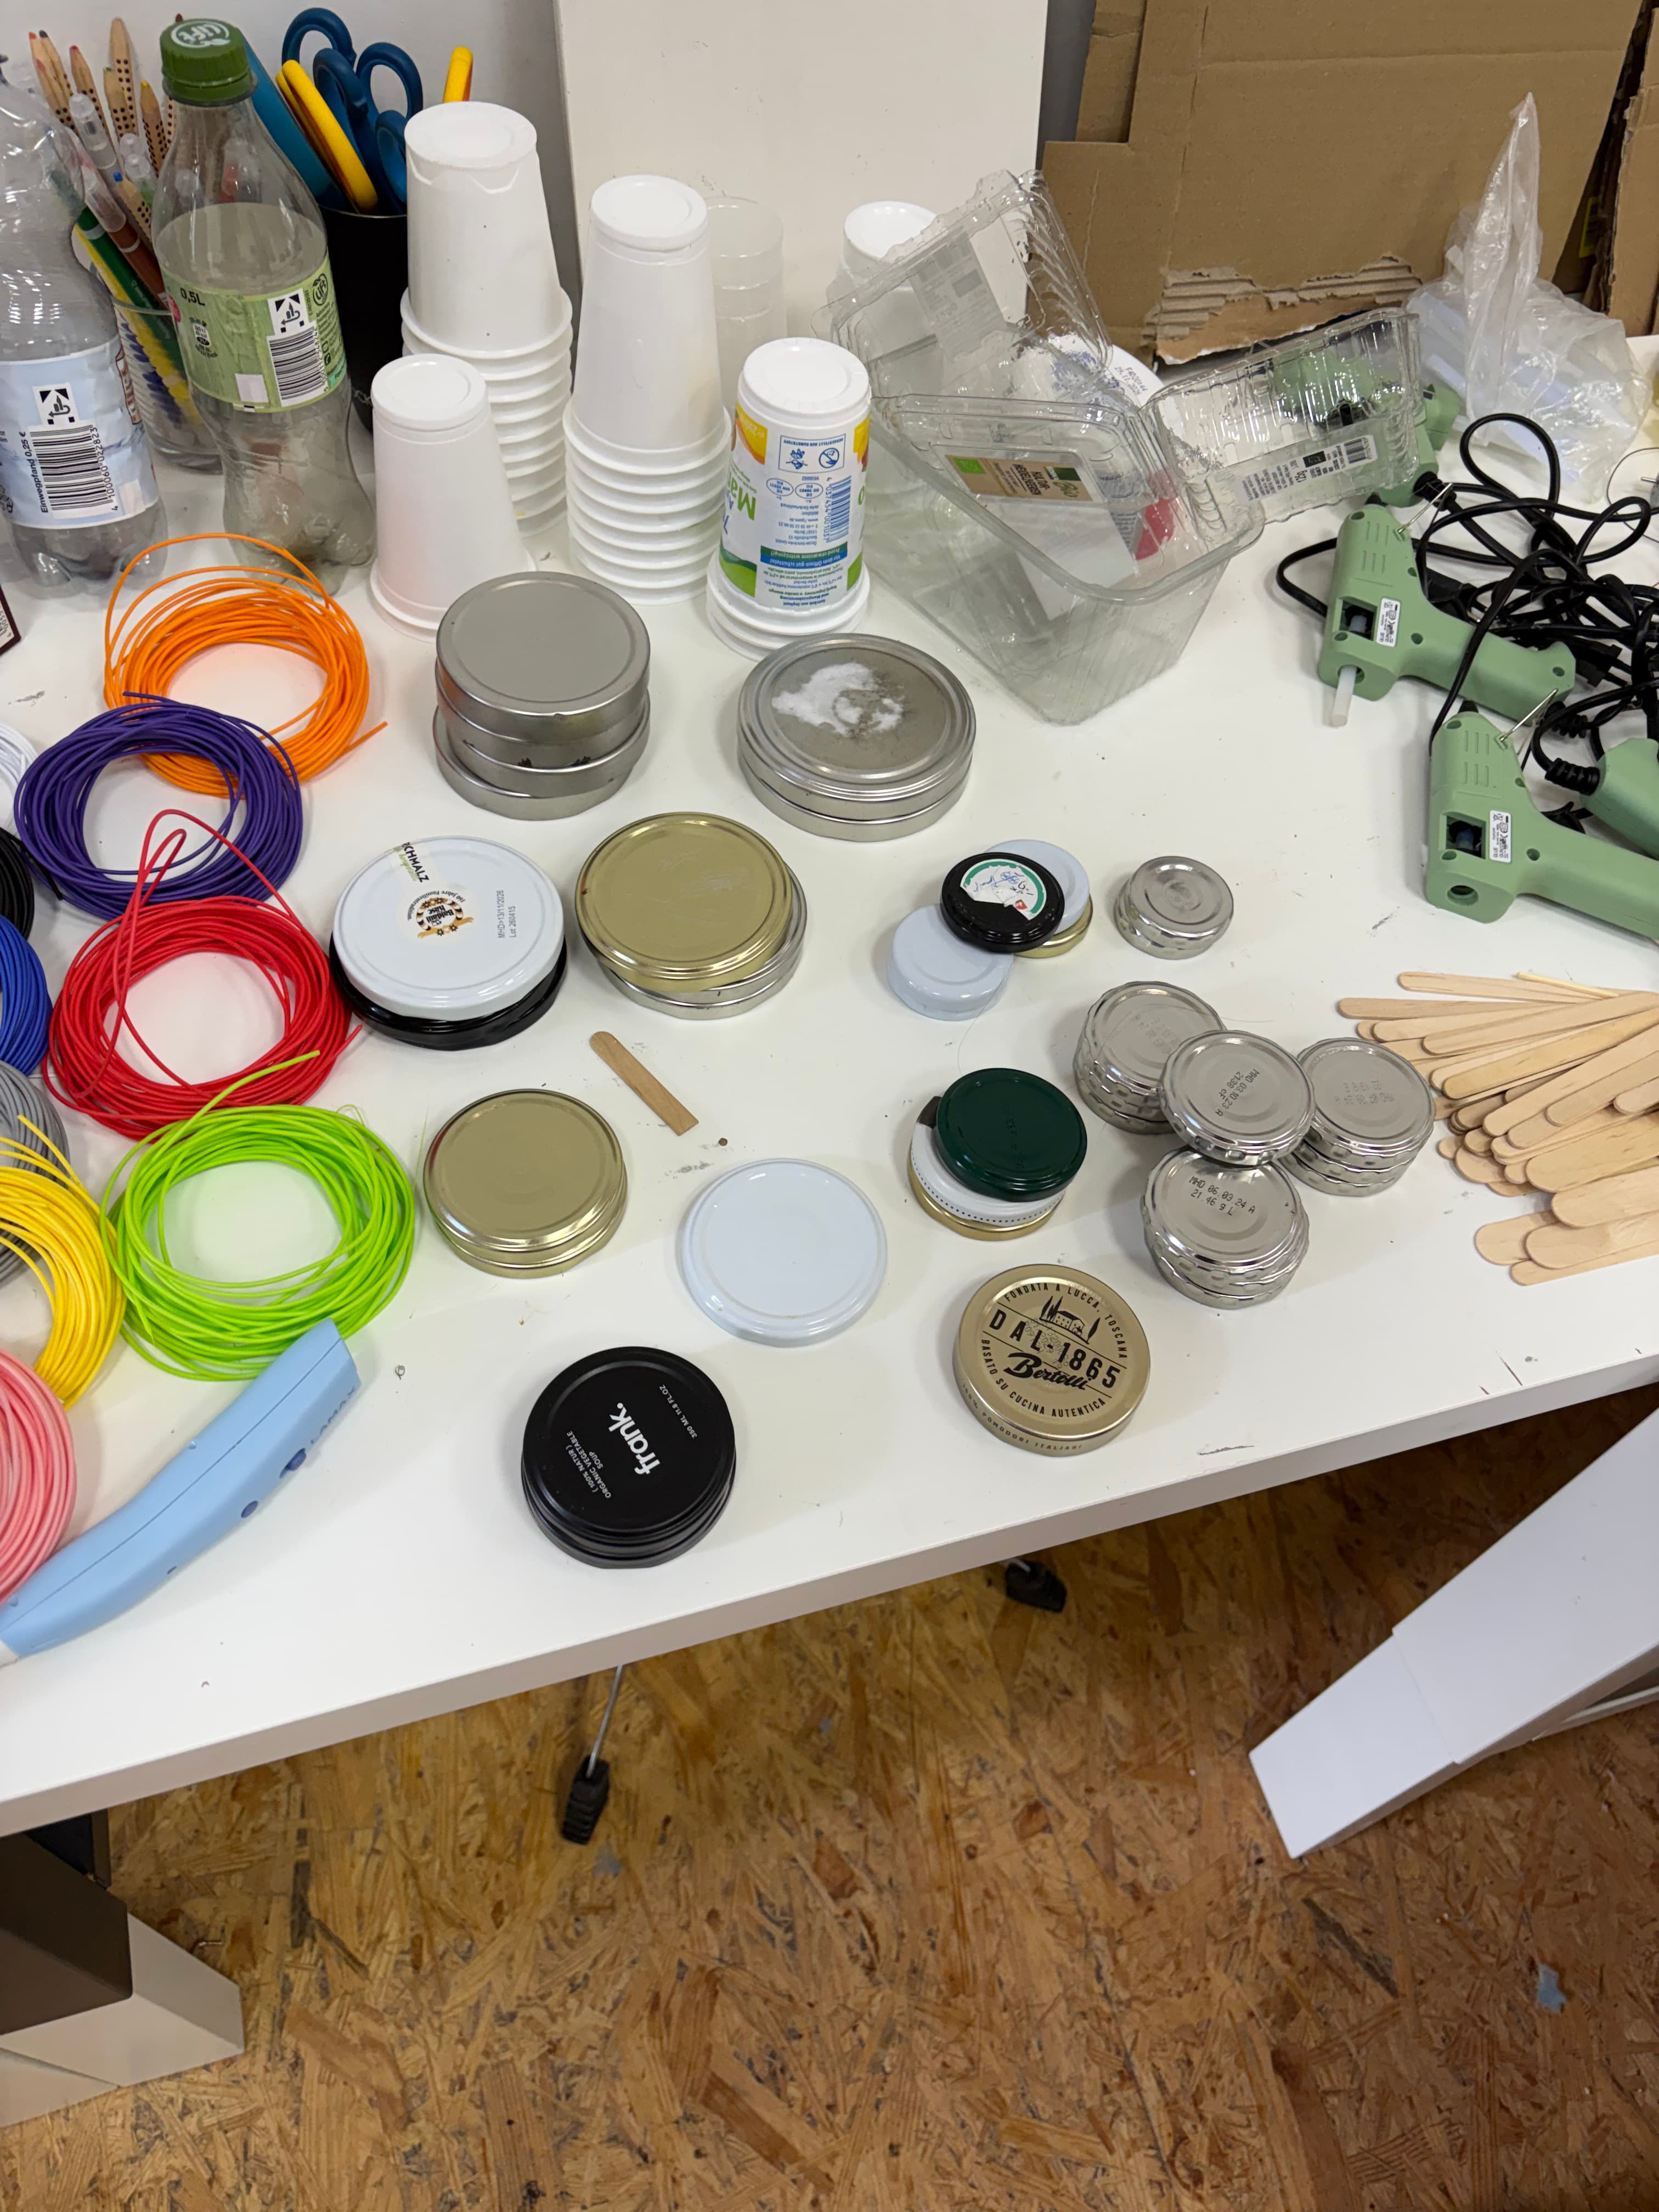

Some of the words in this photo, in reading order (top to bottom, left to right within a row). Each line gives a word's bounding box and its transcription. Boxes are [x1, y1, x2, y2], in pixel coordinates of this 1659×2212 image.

[180, 287, 205, 306] 0,5L
[21, 440, 32, 457] 0,25
[89, 427, 105, 462] 022823
[28, 459, 48, 514] Einwegpfand
[100, 466, 116, 499] 100060
[825, 486, 833, 512] 037454
[509, 928, 517, 938] Lot
[1245, 1069, 1260, 1083] MHD
[1189, 1176, 1206, 1188] MHD
[1248, 1205, 1256, 1214] A
[1227, 1206, 1234, 1216] L
[1004, 1283, 1048, 1302] FONDATA
[1056, 1283, 1060, 1291] A
[1068, 1286, 1100, 1313] LUCCA,
[1104, 1313, 1127, 1359] TOSCANA
[981, 1339, 998, 1375] BASATO
[996, 1378, 1009, 1390] SU
[1009, 1391, 1045, 1415] CUCINA
[1052, 1397, 1106, 1418] AUTENTICA
[1003, 1352, 1092, 1390] Bertolli
[659, 1384, 674, 1404] FL.OZ
[672, 1403, 682, 1415] 11.8
[680, 1414, 689, 1426] ML
[608, 1402, 661, 1475] frank.
[686, 1425, 697, 1439] 350
[981, 1412, 1030, 1444] POMODORI
[1035, 1442, 1083, 1451] ITALIANI
[567, 1430, 592, 1468] VEGETABLE
[589, 1451, 603, 1469] SOUP
[589, 1466, 611, 1498] ORGANIC
